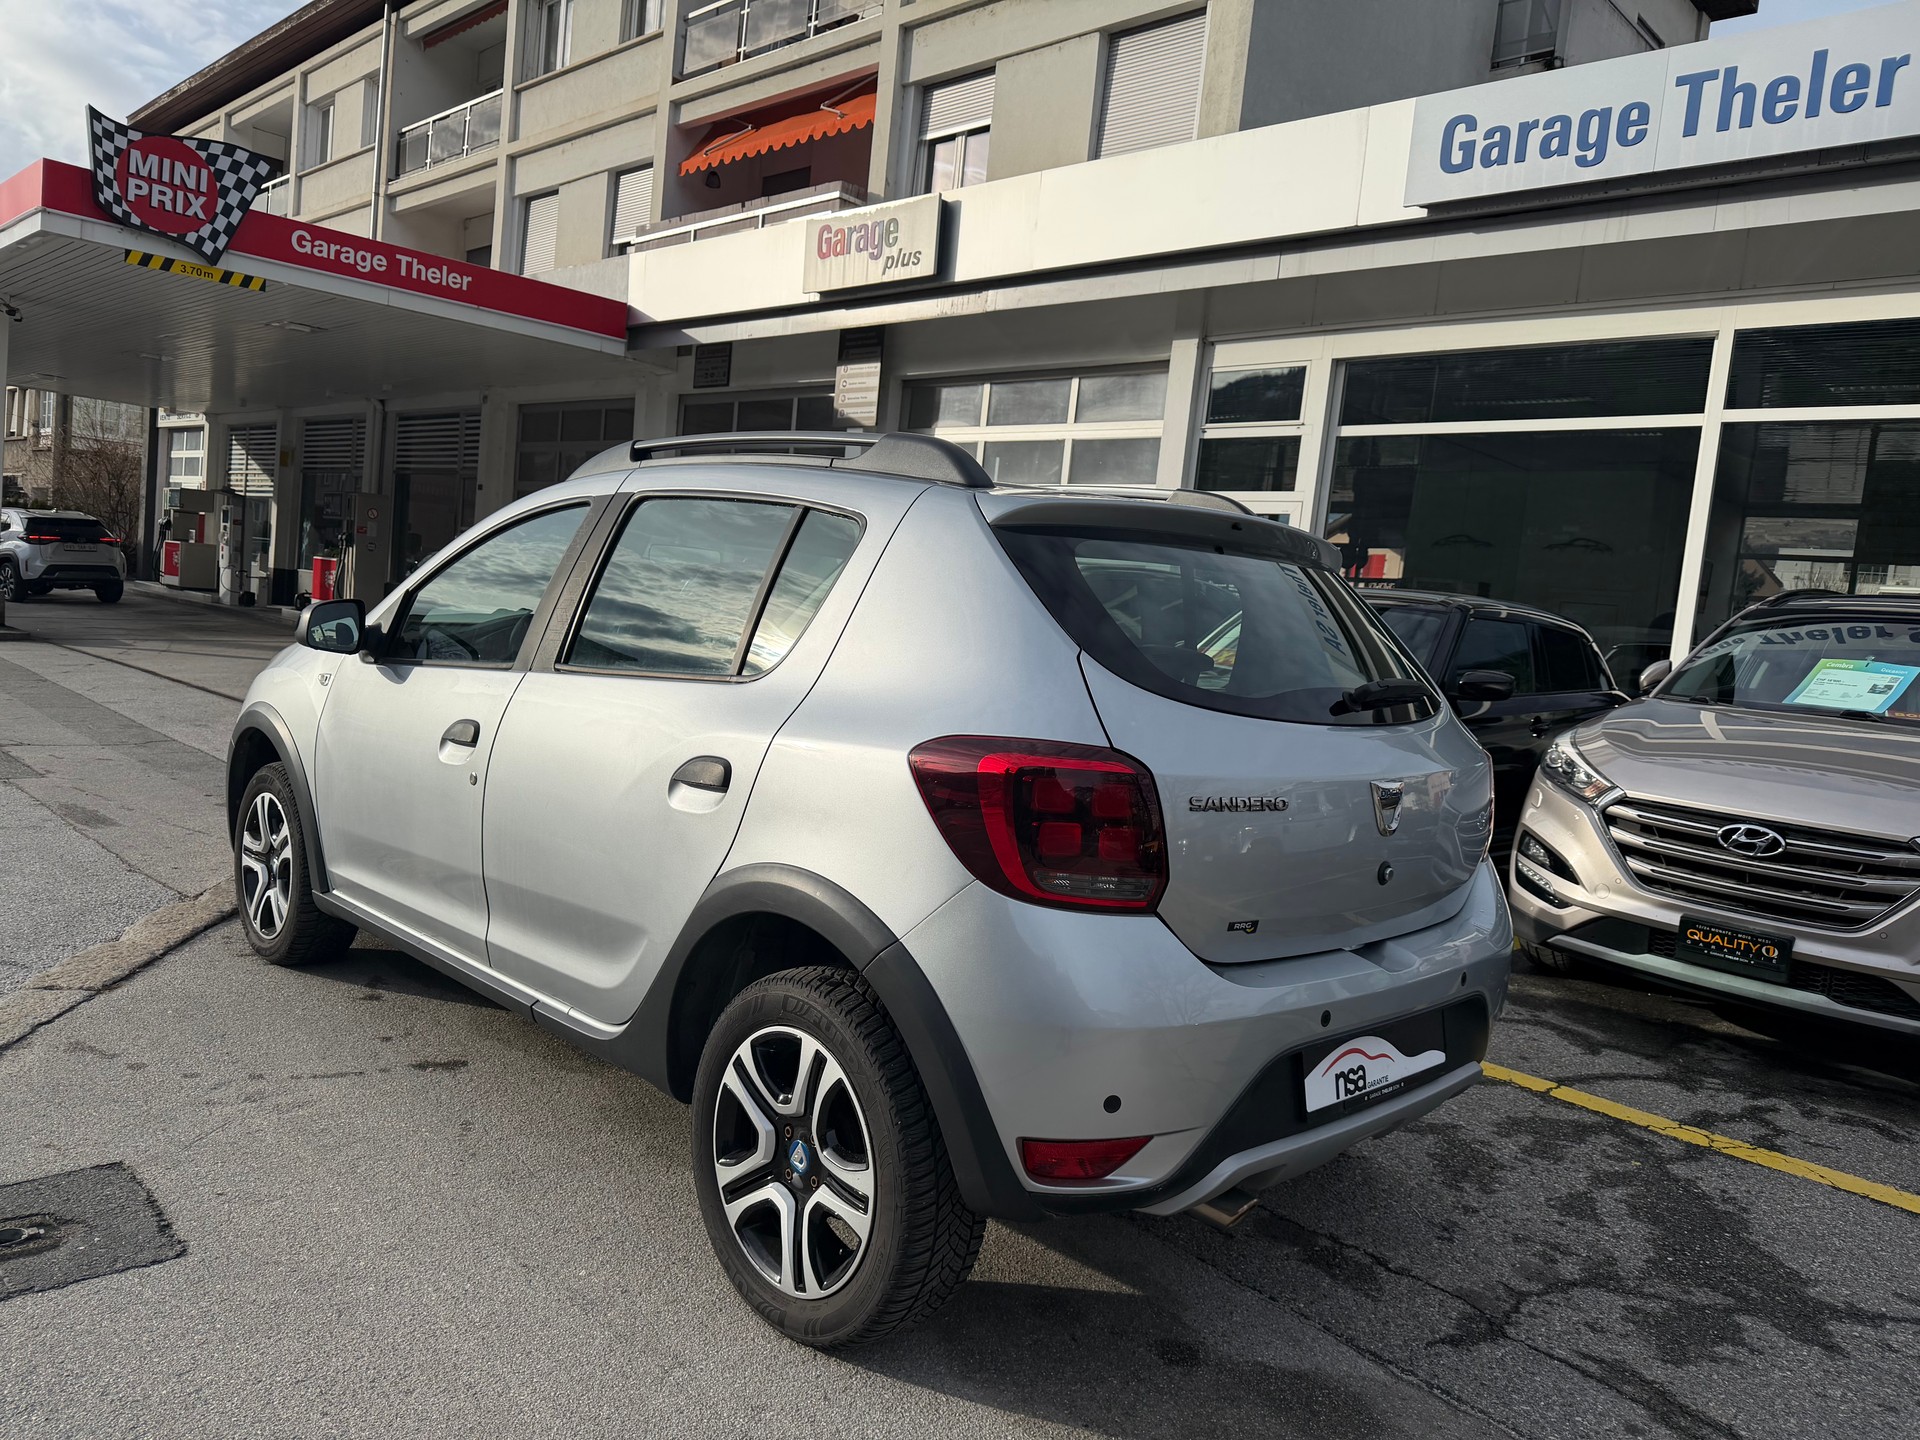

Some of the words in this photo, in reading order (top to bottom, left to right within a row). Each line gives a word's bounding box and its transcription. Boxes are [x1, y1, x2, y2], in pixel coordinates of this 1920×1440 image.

[1438, 100, 1651, 174] Garage
[1674, 48, 1911, 138] Theler
[129, 148, 209, 193] MINI
[127, 177, 208, 221] PRIX
[817, 217, 899, 261] Garage
[290, 229, 388, 273] Garage
[395, 253, 473, 291] Theler
[881, 247, 922, 276] plus
[1826, 661, 1854, 669] Cembra
[1880, 667, 1909, 675] Occasion
[1189, 796, 1289, 812] SANDERO
[1233, 922, 1252, 930] RRG
[1687, 928, 1761, 953] QUALITY
[1334, 1064, 1367, 1100] nsa
[1366, 1074, 1389, 1089] GARANTIE
